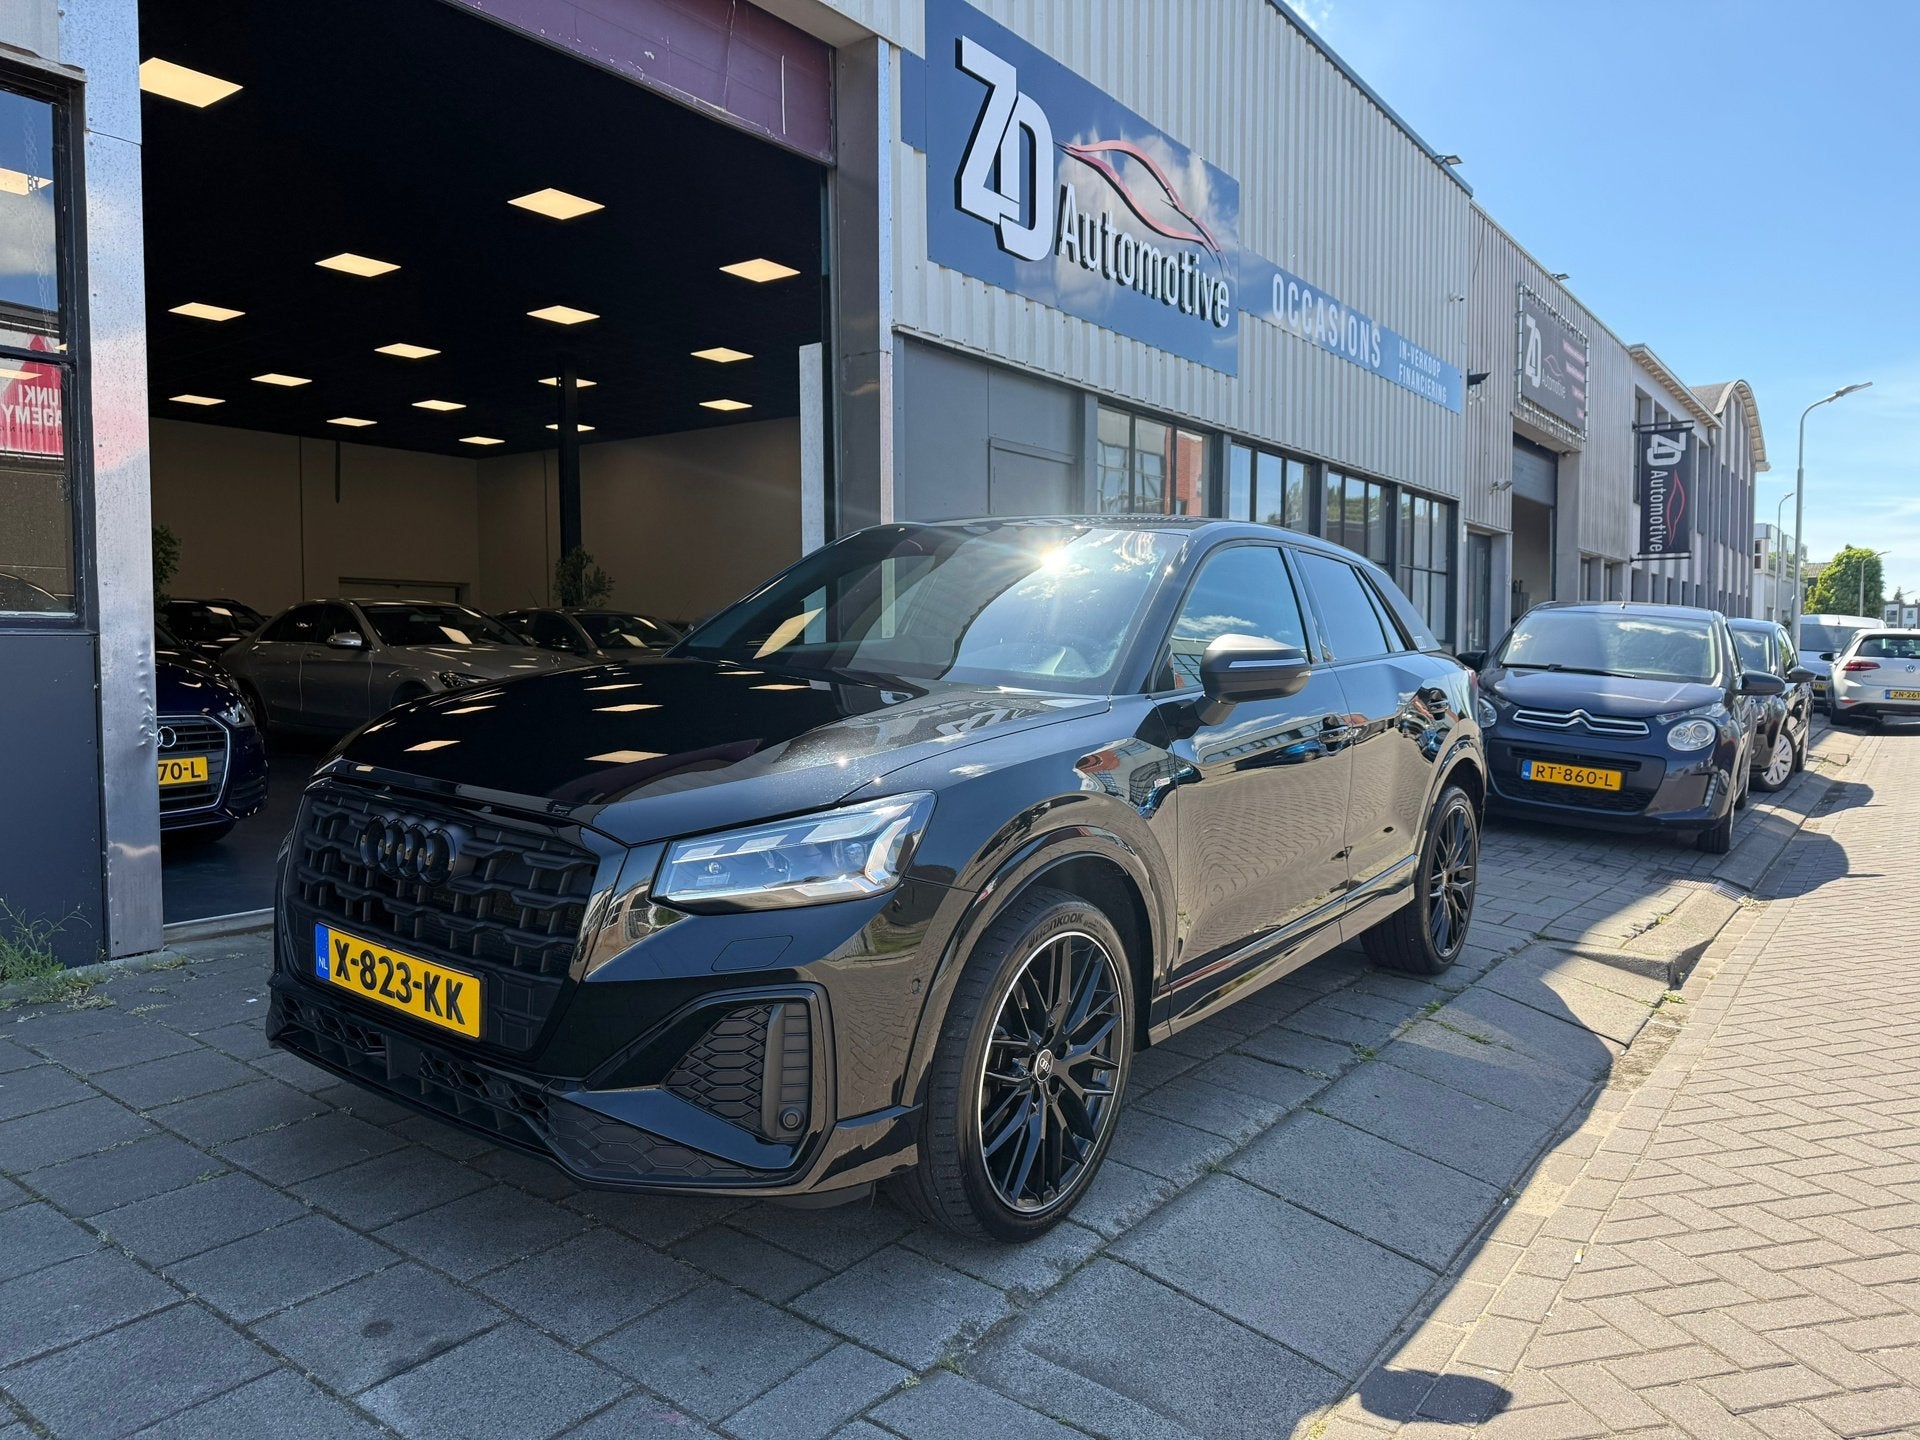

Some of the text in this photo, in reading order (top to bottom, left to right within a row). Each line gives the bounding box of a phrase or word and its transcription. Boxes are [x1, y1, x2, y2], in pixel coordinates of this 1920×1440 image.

[957, 35, 1054, 261] ZD
[1057, 182, 1230, 328] Automotive
[1272, 273, 1381, 369] OCCASIONS
[1399, 339, 1441, 379] IN-VERKOOP
[1398, 363, 1447, 403] FINANCIERING
[1649, 470, 1669, 552] Automotive
[1536, 764, 1613, 787] RT-860-L
[318, 938, 466, 1026] NL X-823-KK
